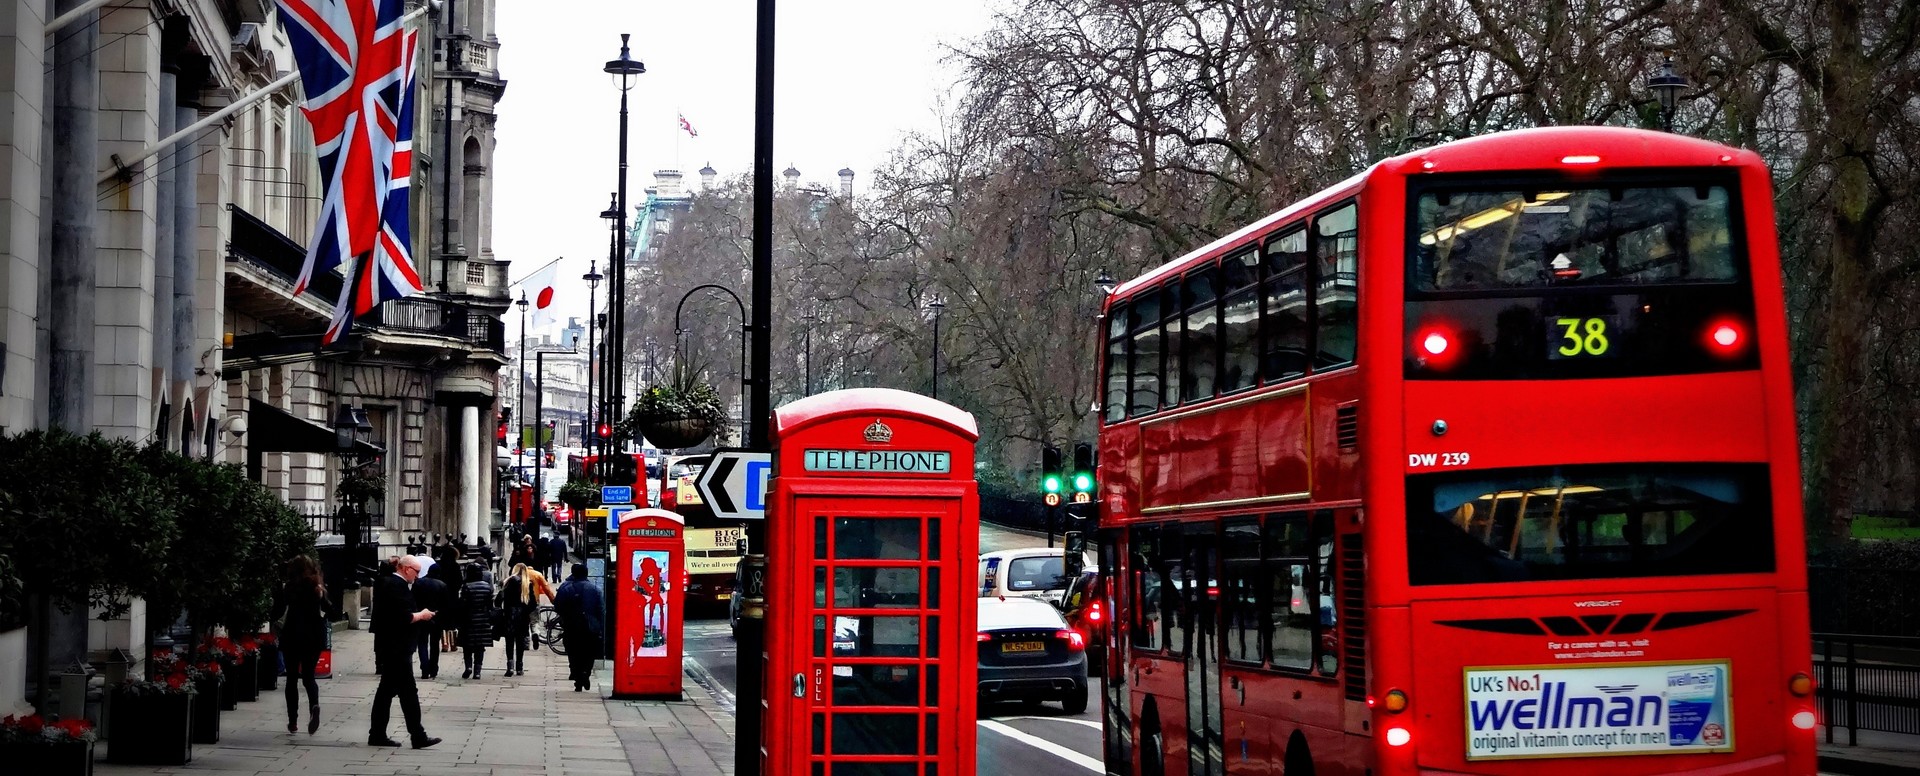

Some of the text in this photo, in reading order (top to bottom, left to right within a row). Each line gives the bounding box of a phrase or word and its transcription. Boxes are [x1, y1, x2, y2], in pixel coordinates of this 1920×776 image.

[1556, 317, 1609, 356] 38
[809, 451, 945, 471] TELEPHONE
[1408, 452, 1470, 466] DW 239
[1631, 639, 1650, 647] visit
[1470, 674, 1541, 692] UK's No.1
[1470, 682, 1662, 731] wellman
[1473, 732, 1520, 752] original
[1523, 731, 1569, 748] vitamin
[1572, 731, 1617, 749] concept
[1620, 729, 1636, 745] for
[1640, 731, 1666, 745] men
